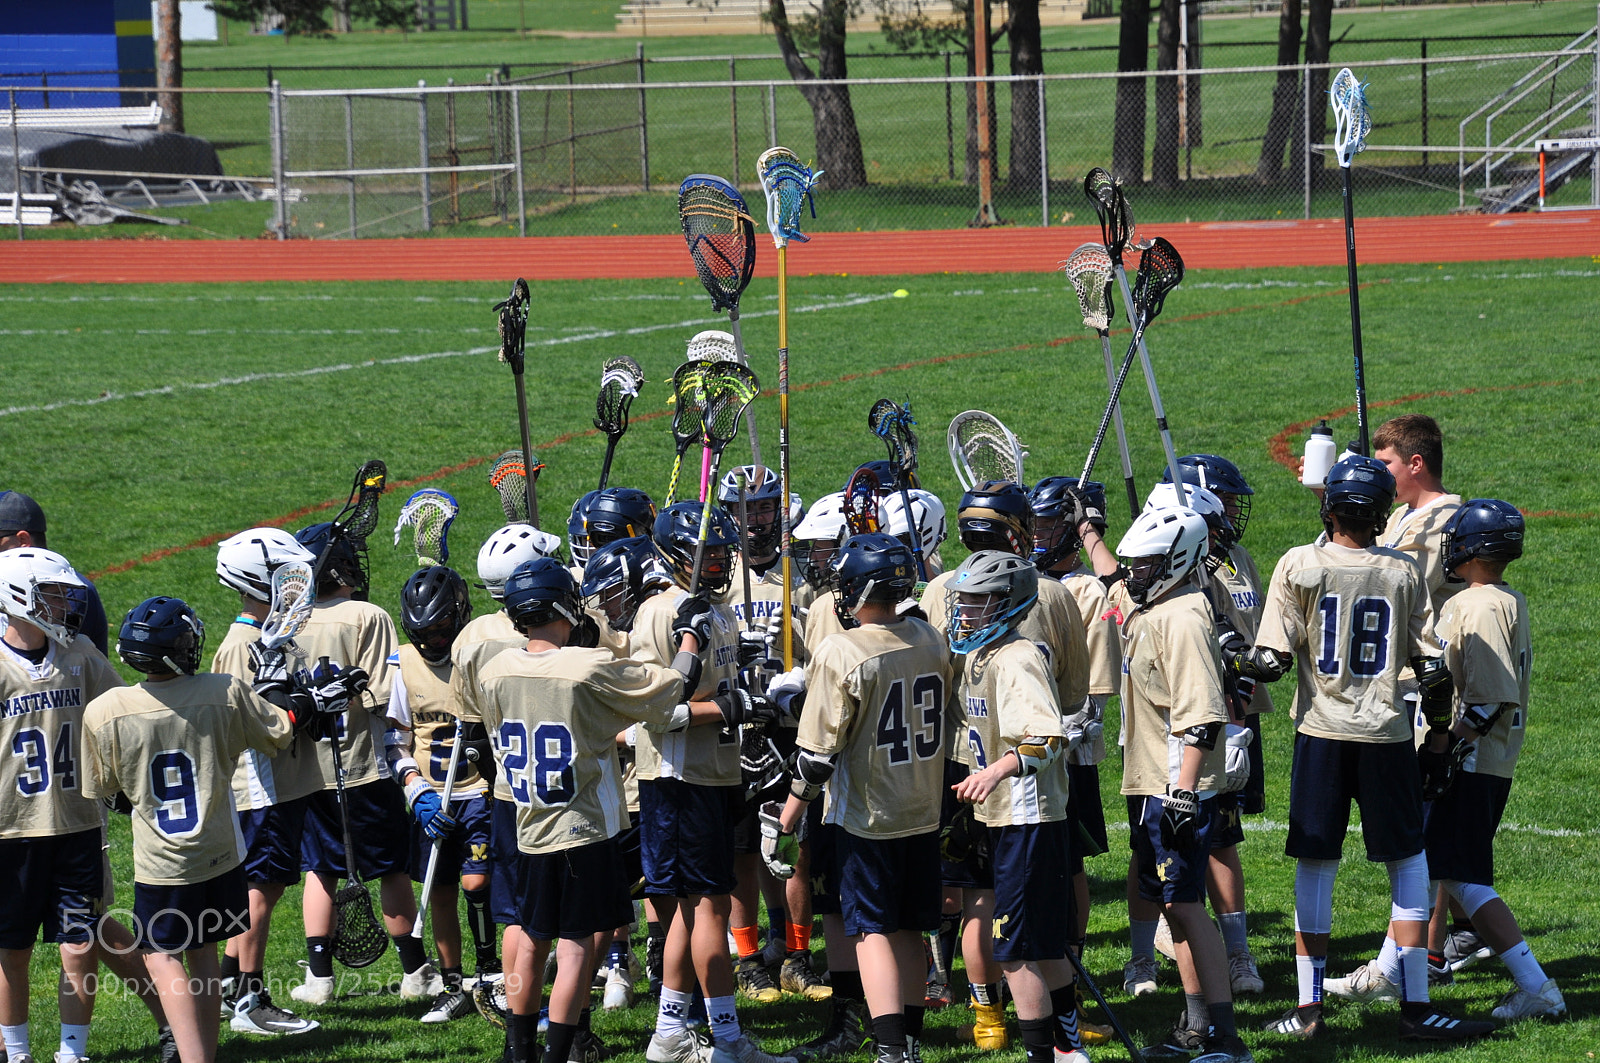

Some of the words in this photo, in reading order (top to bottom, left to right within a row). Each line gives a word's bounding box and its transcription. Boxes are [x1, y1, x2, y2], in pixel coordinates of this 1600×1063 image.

[1315, 593, 1393, 678] 18
[0, 688, 82, 719] MATTAWAN
[876, 672, 945, 767] 43
[12, 720, 77, 798] 34
[149, 749, 203, 838] 9
[499, 719, 579, 807] 28
